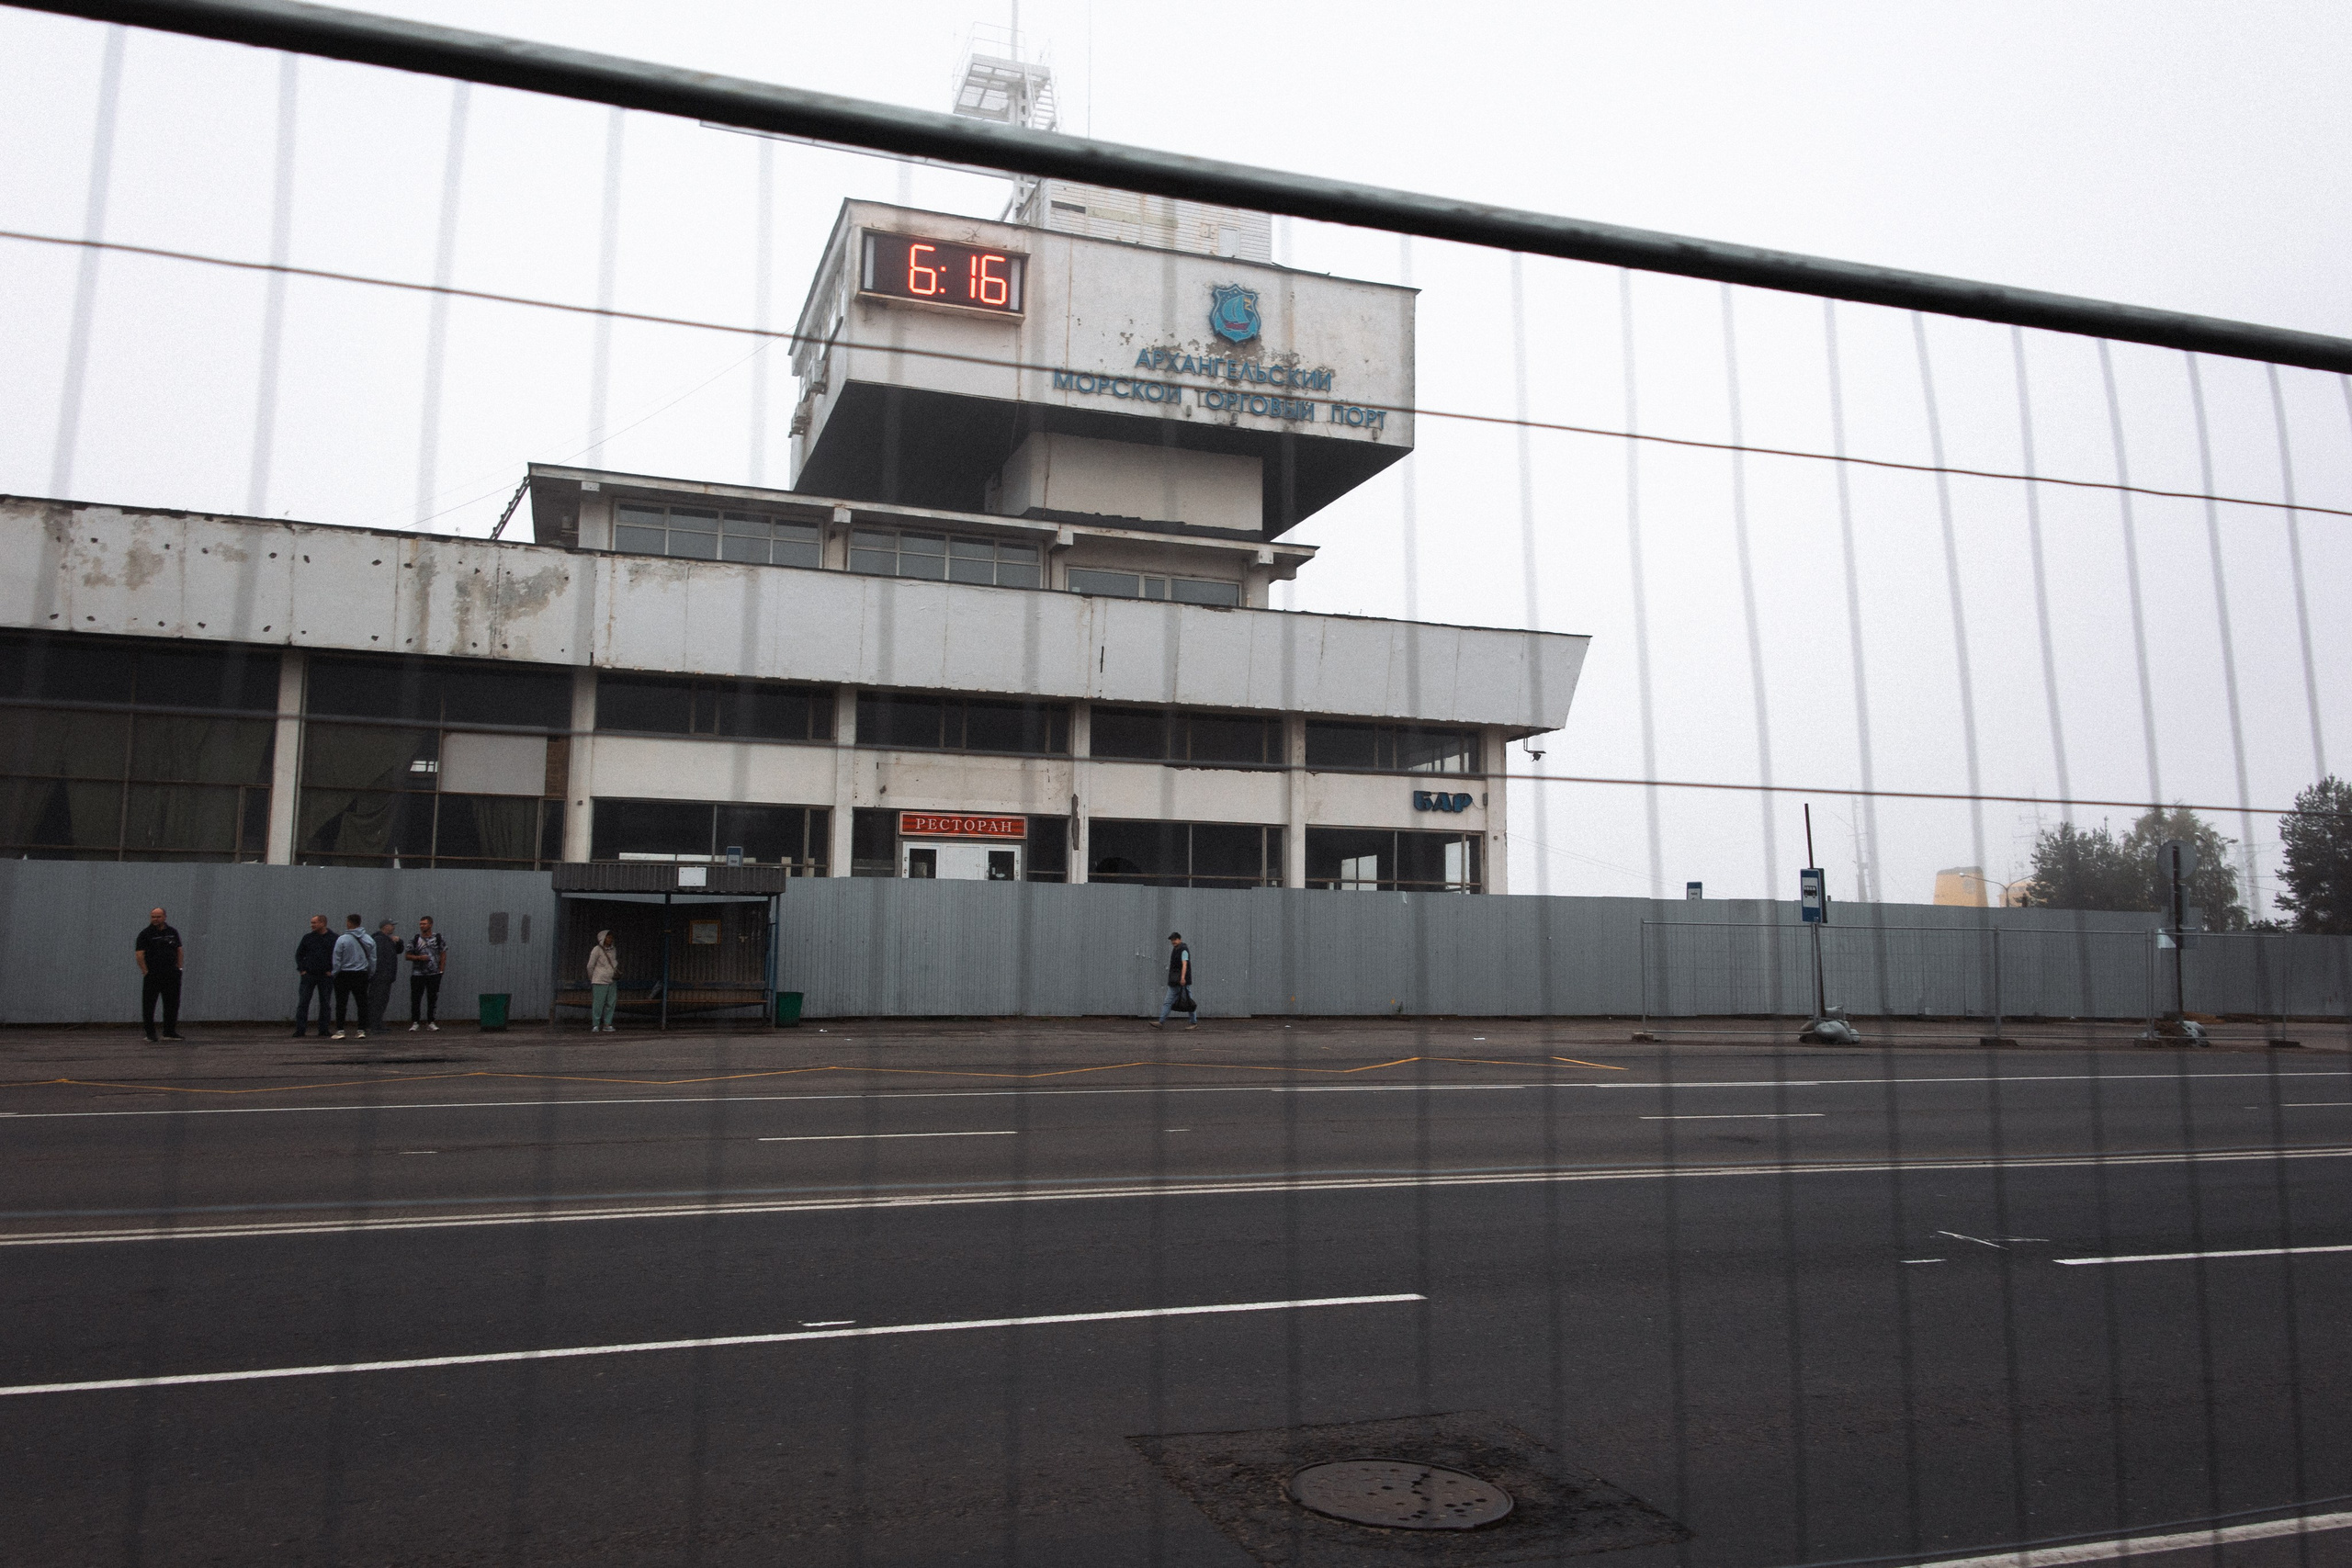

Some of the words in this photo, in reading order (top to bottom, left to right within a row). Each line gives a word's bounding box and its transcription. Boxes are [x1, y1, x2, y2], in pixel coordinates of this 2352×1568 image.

[909, 243, 1007, 305] 6:16
[1331, 404, 1387, 430] ПОРТ
[1413, 790, 1473, 813] БАР
[915, 818, 1012, 832] РЕСТОРАН
